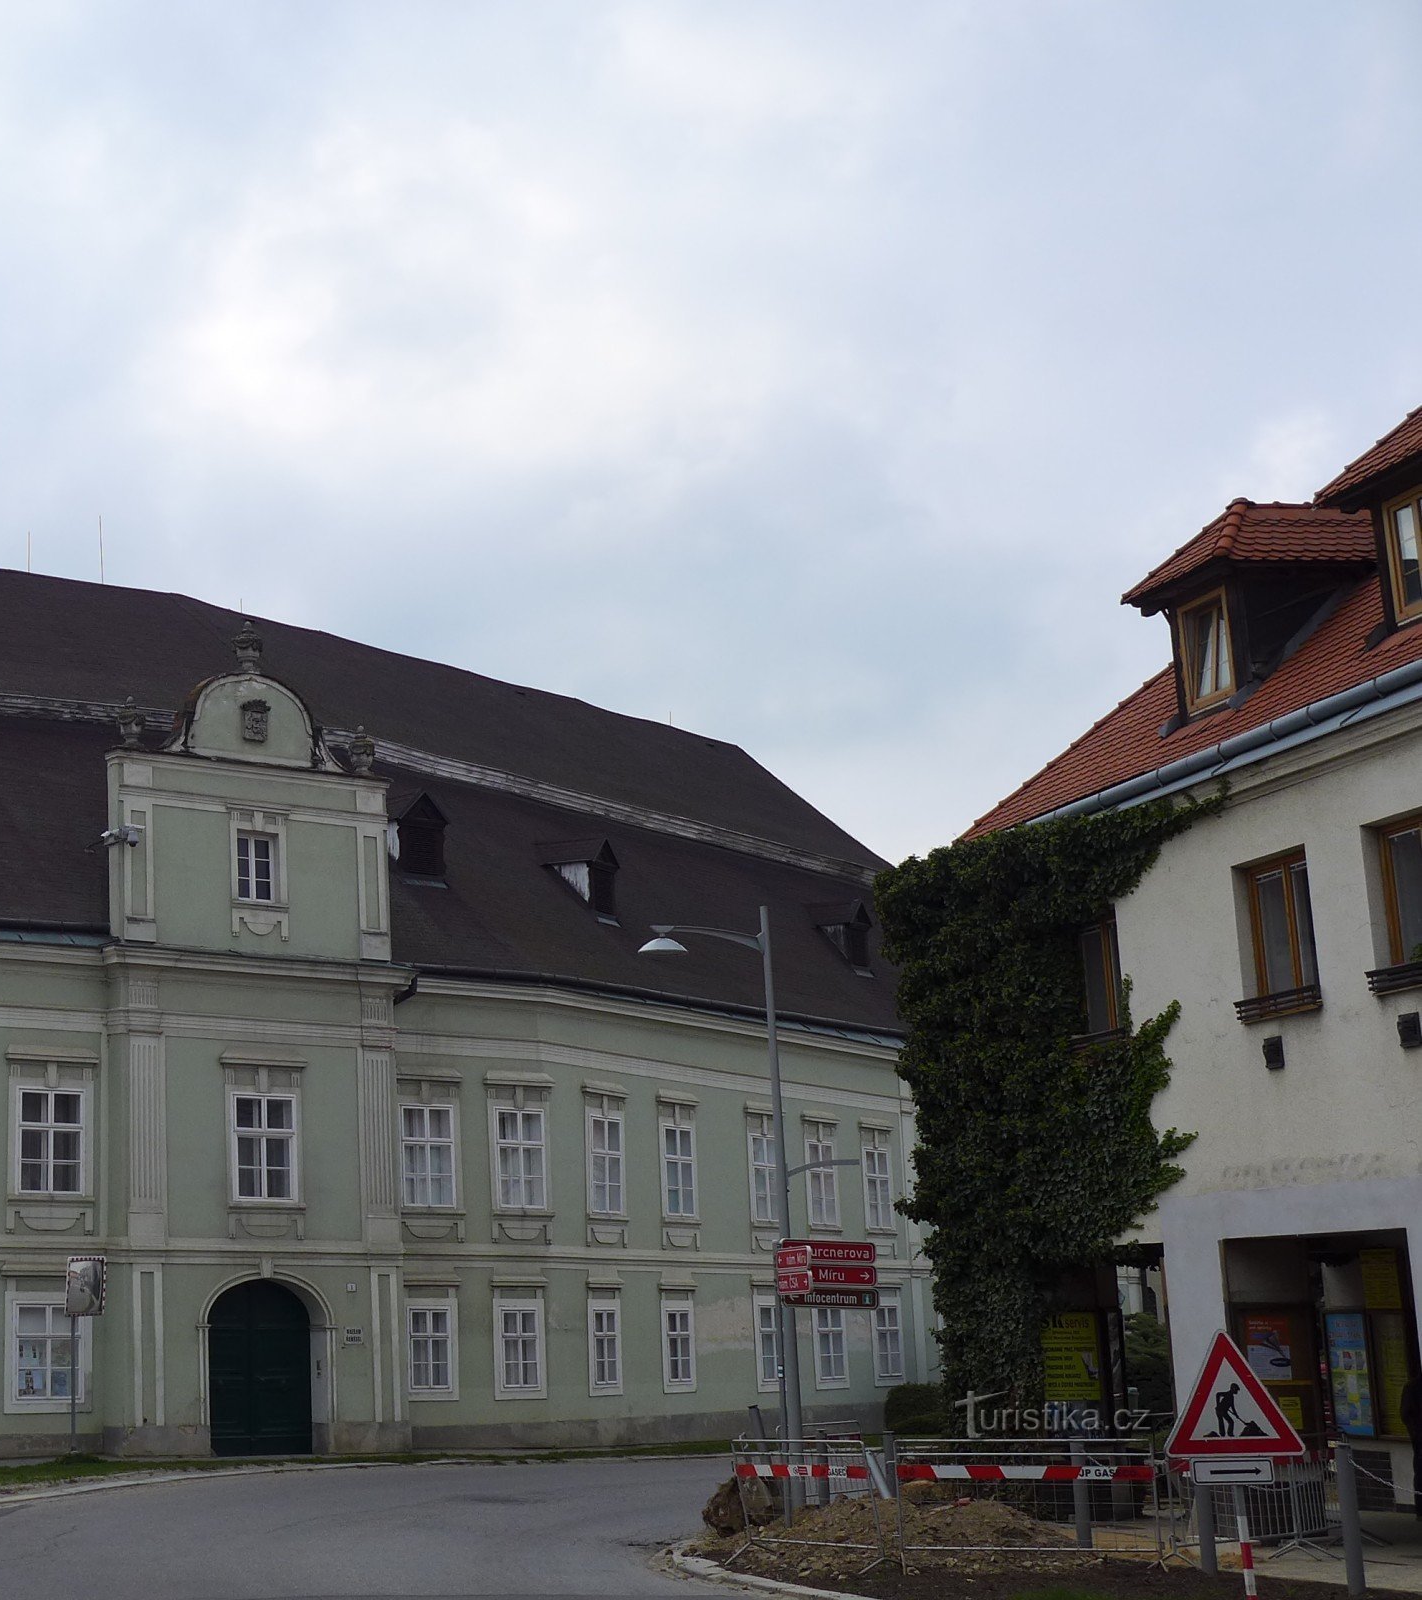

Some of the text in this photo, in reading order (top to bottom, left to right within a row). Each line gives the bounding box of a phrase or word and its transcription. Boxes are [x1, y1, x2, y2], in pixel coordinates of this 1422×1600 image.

[812, 1247, 870, 1259] urcnerova
[818, 1268, 845, 1281] Míru
[804, 1291, 857, 1304] Infocentrum
